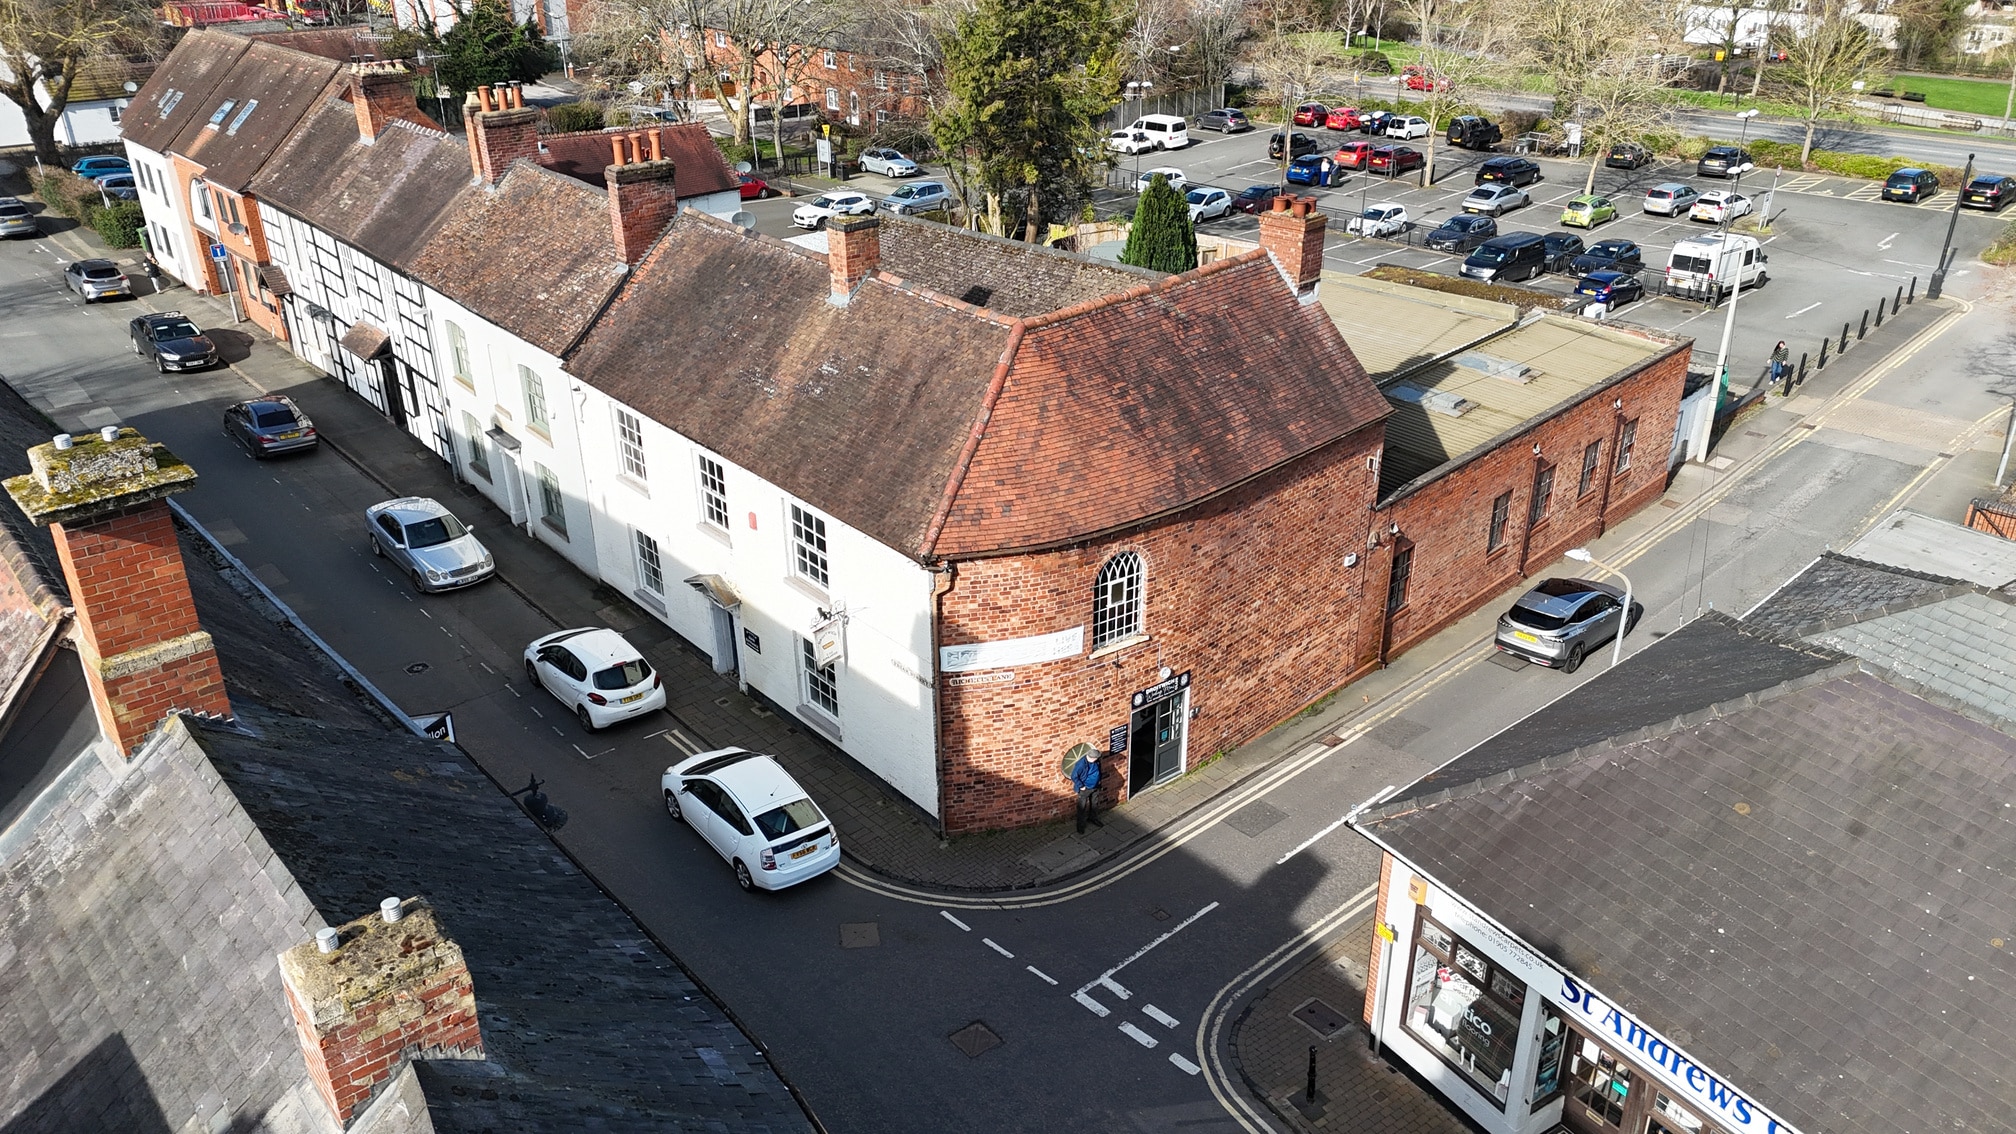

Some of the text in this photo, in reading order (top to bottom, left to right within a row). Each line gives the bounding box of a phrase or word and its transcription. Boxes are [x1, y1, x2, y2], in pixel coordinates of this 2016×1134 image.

[1488, 935, 1508, 953] 01905
[1508, 947, 1533, 970] 772845
[1560, 976, 1753, 1125] St Andrews
